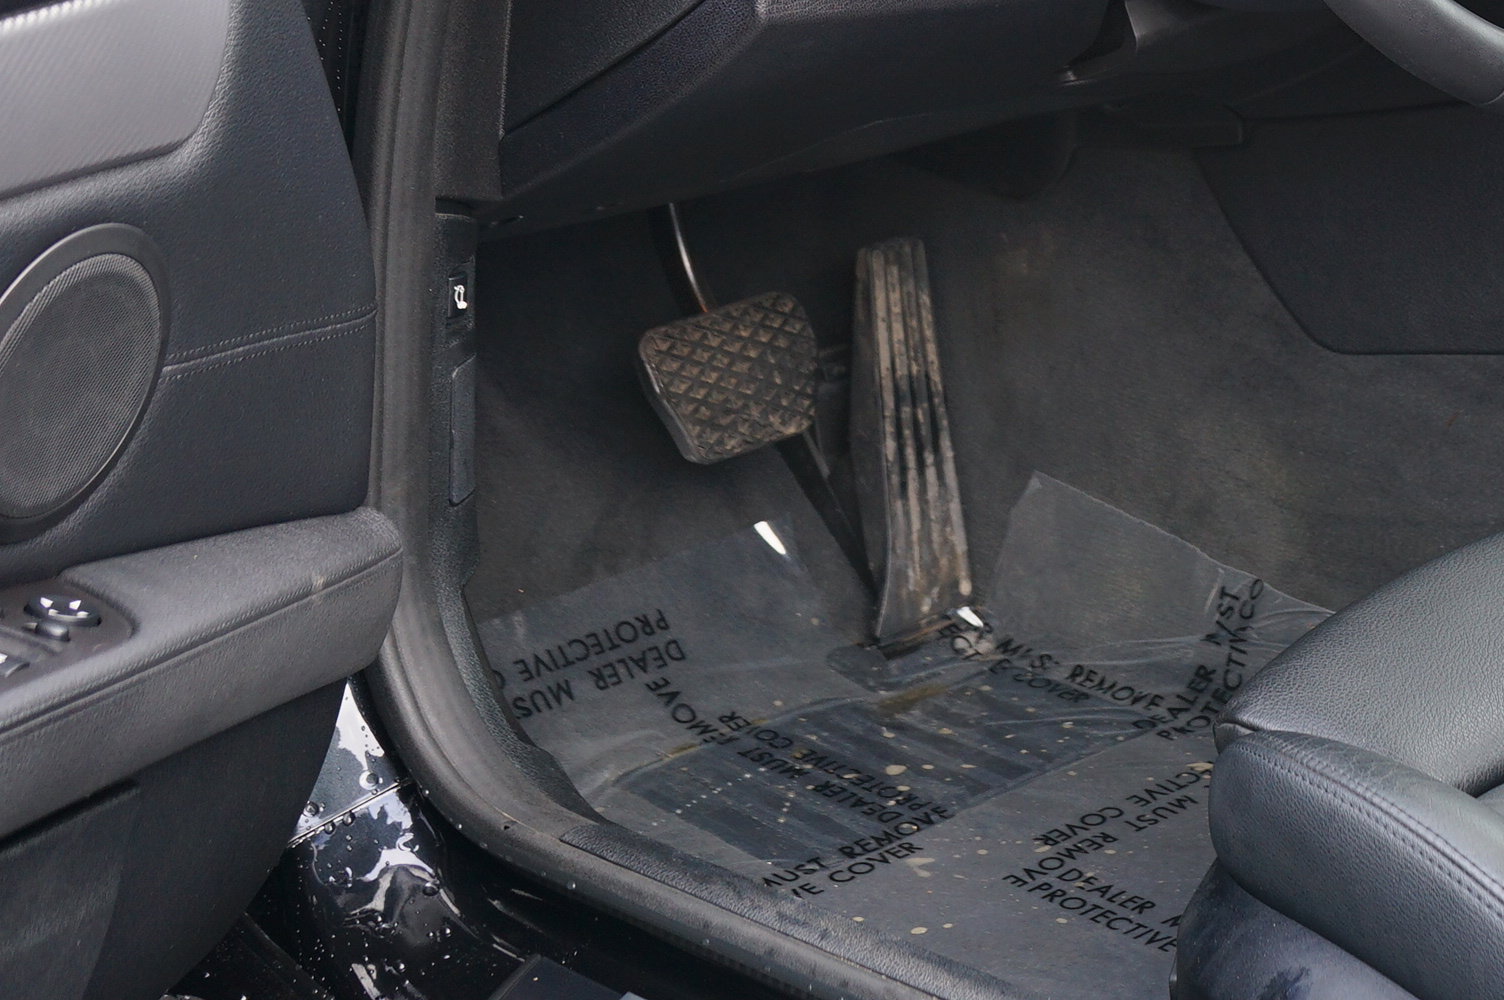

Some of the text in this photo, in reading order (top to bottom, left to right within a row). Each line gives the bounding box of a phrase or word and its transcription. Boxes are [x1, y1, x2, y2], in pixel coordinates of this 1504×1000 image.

[512, 608, 670, 683] PROTECTIVE
[587, 639, 687, 692] DEALER
[510, 678, 575, 720] MUS
[1065, 662, 1165, 713] REMOVE
[738, 746, 806, 780] MUST
[813, 778, 903, 825] DEALER
[837, 804, 955, 857] REMOVE
[1002, 794, 1199, 888] MUST REMOVE
[1032, 805, 1124, 849] COVER
[828, 839, 924, 882] COVER
[1056, 866, 1157, 915] DEALER
[1027, 881, 1176, 953] PROTECTIVE
